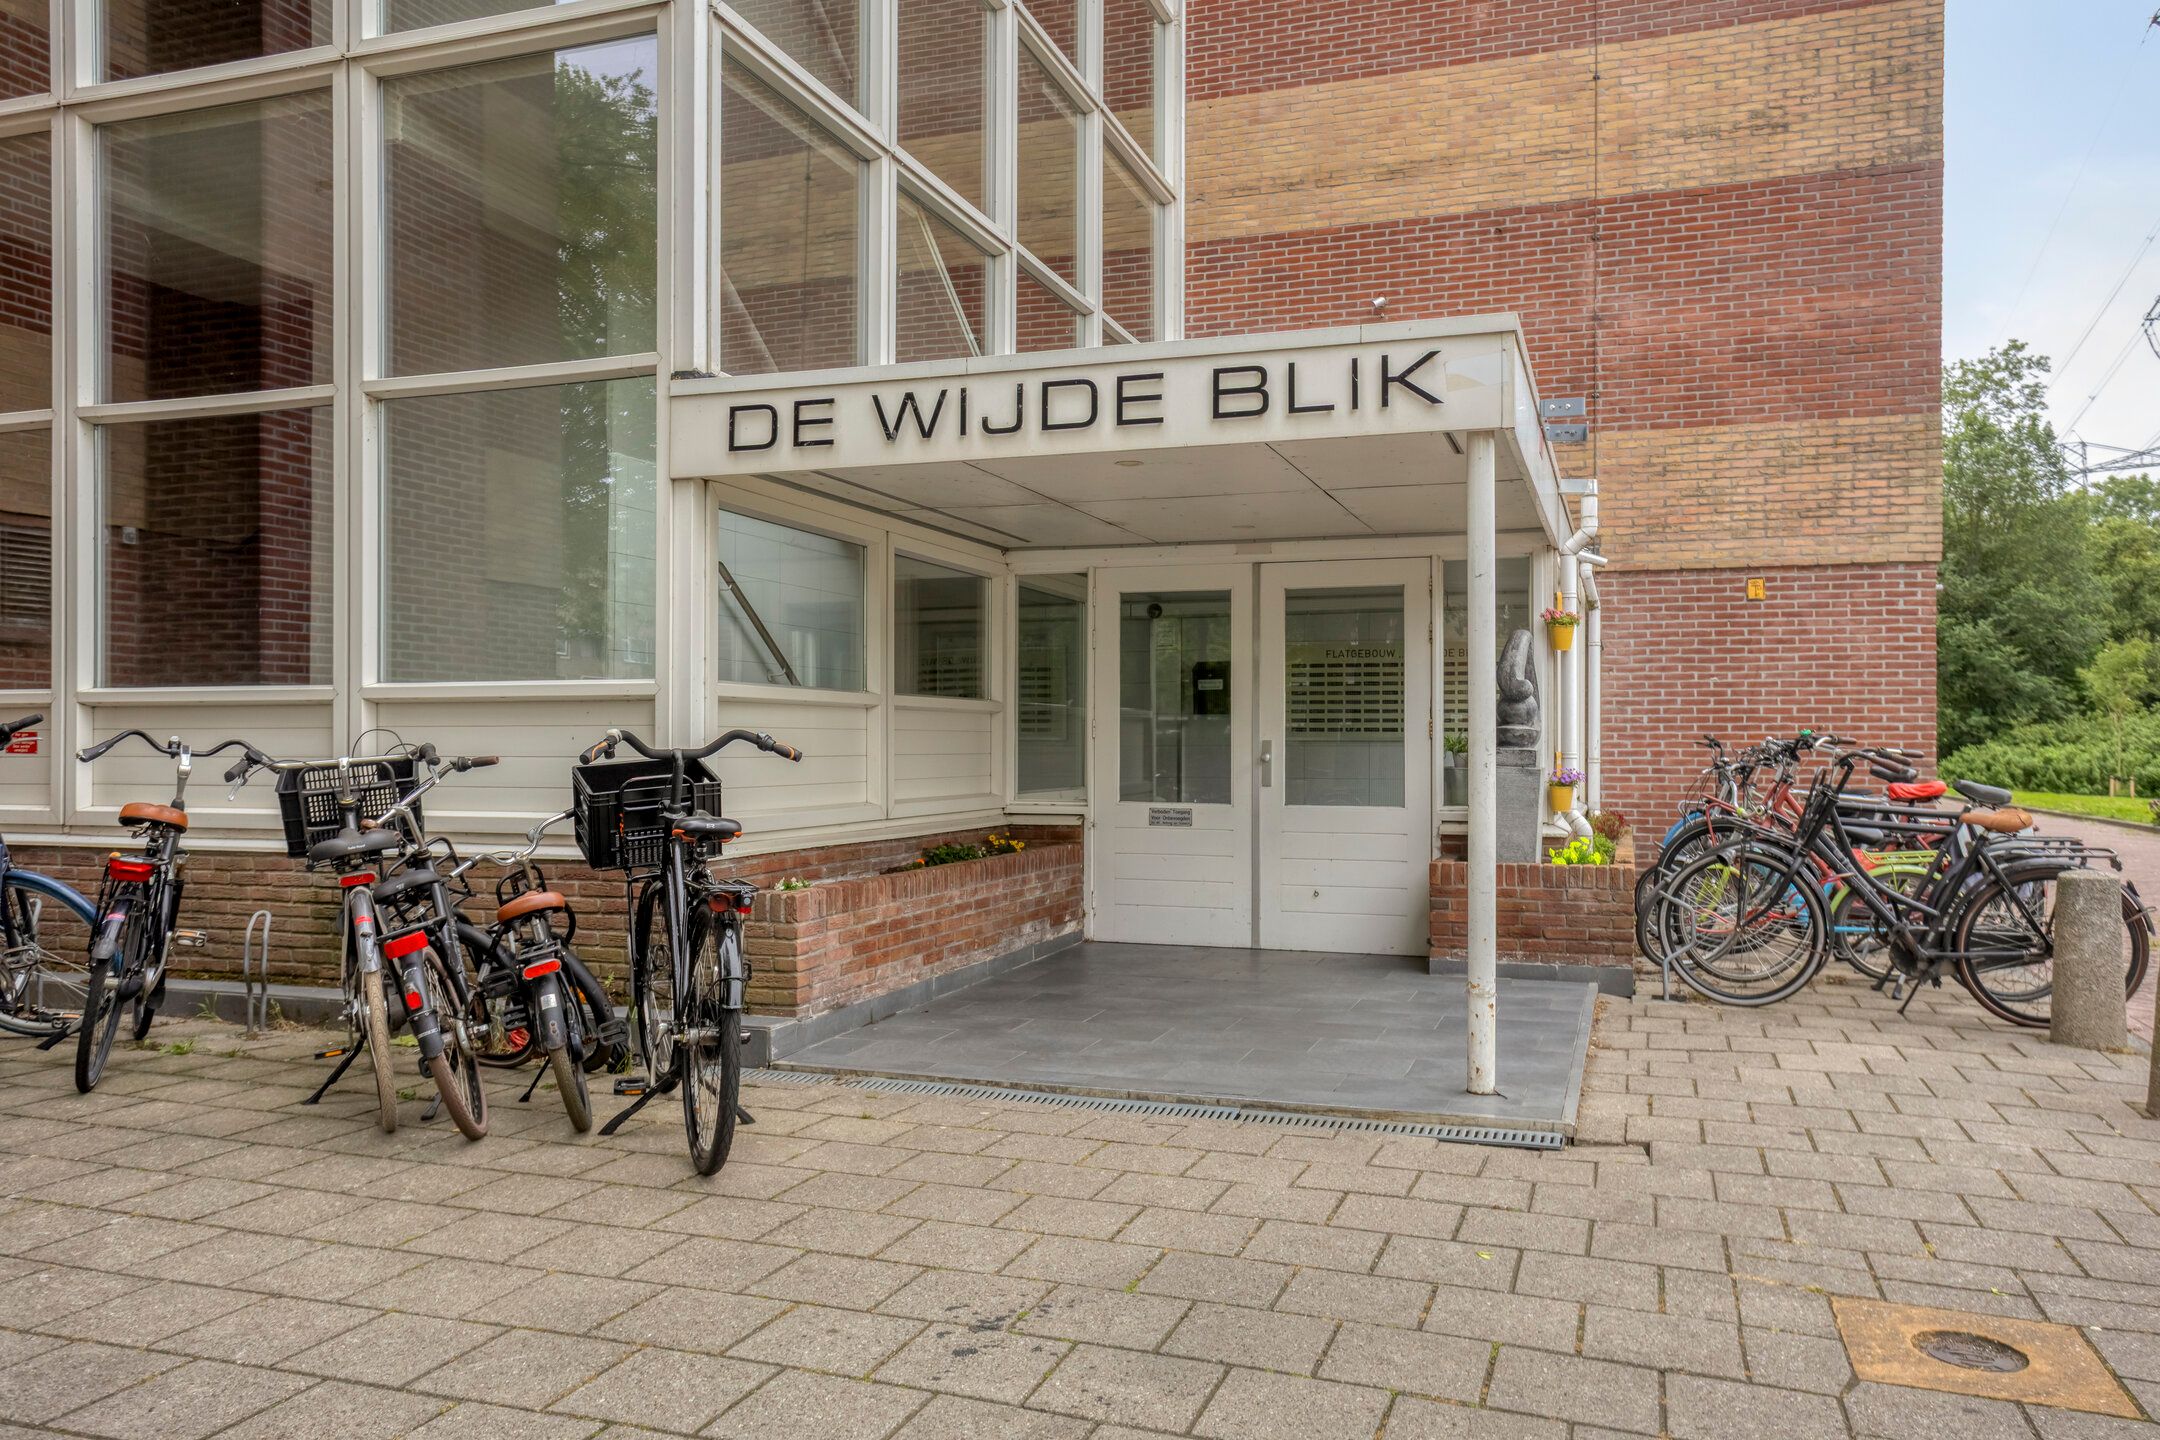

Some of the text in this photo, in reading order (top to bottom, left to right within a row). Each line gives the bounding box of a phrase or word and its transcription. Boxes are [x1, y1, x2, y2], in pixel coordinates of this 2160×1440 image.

[728, 350, 1445, 453] DE WIJDE BLIK
[1325, 648, 1396, 658] FLATGEBOUW
